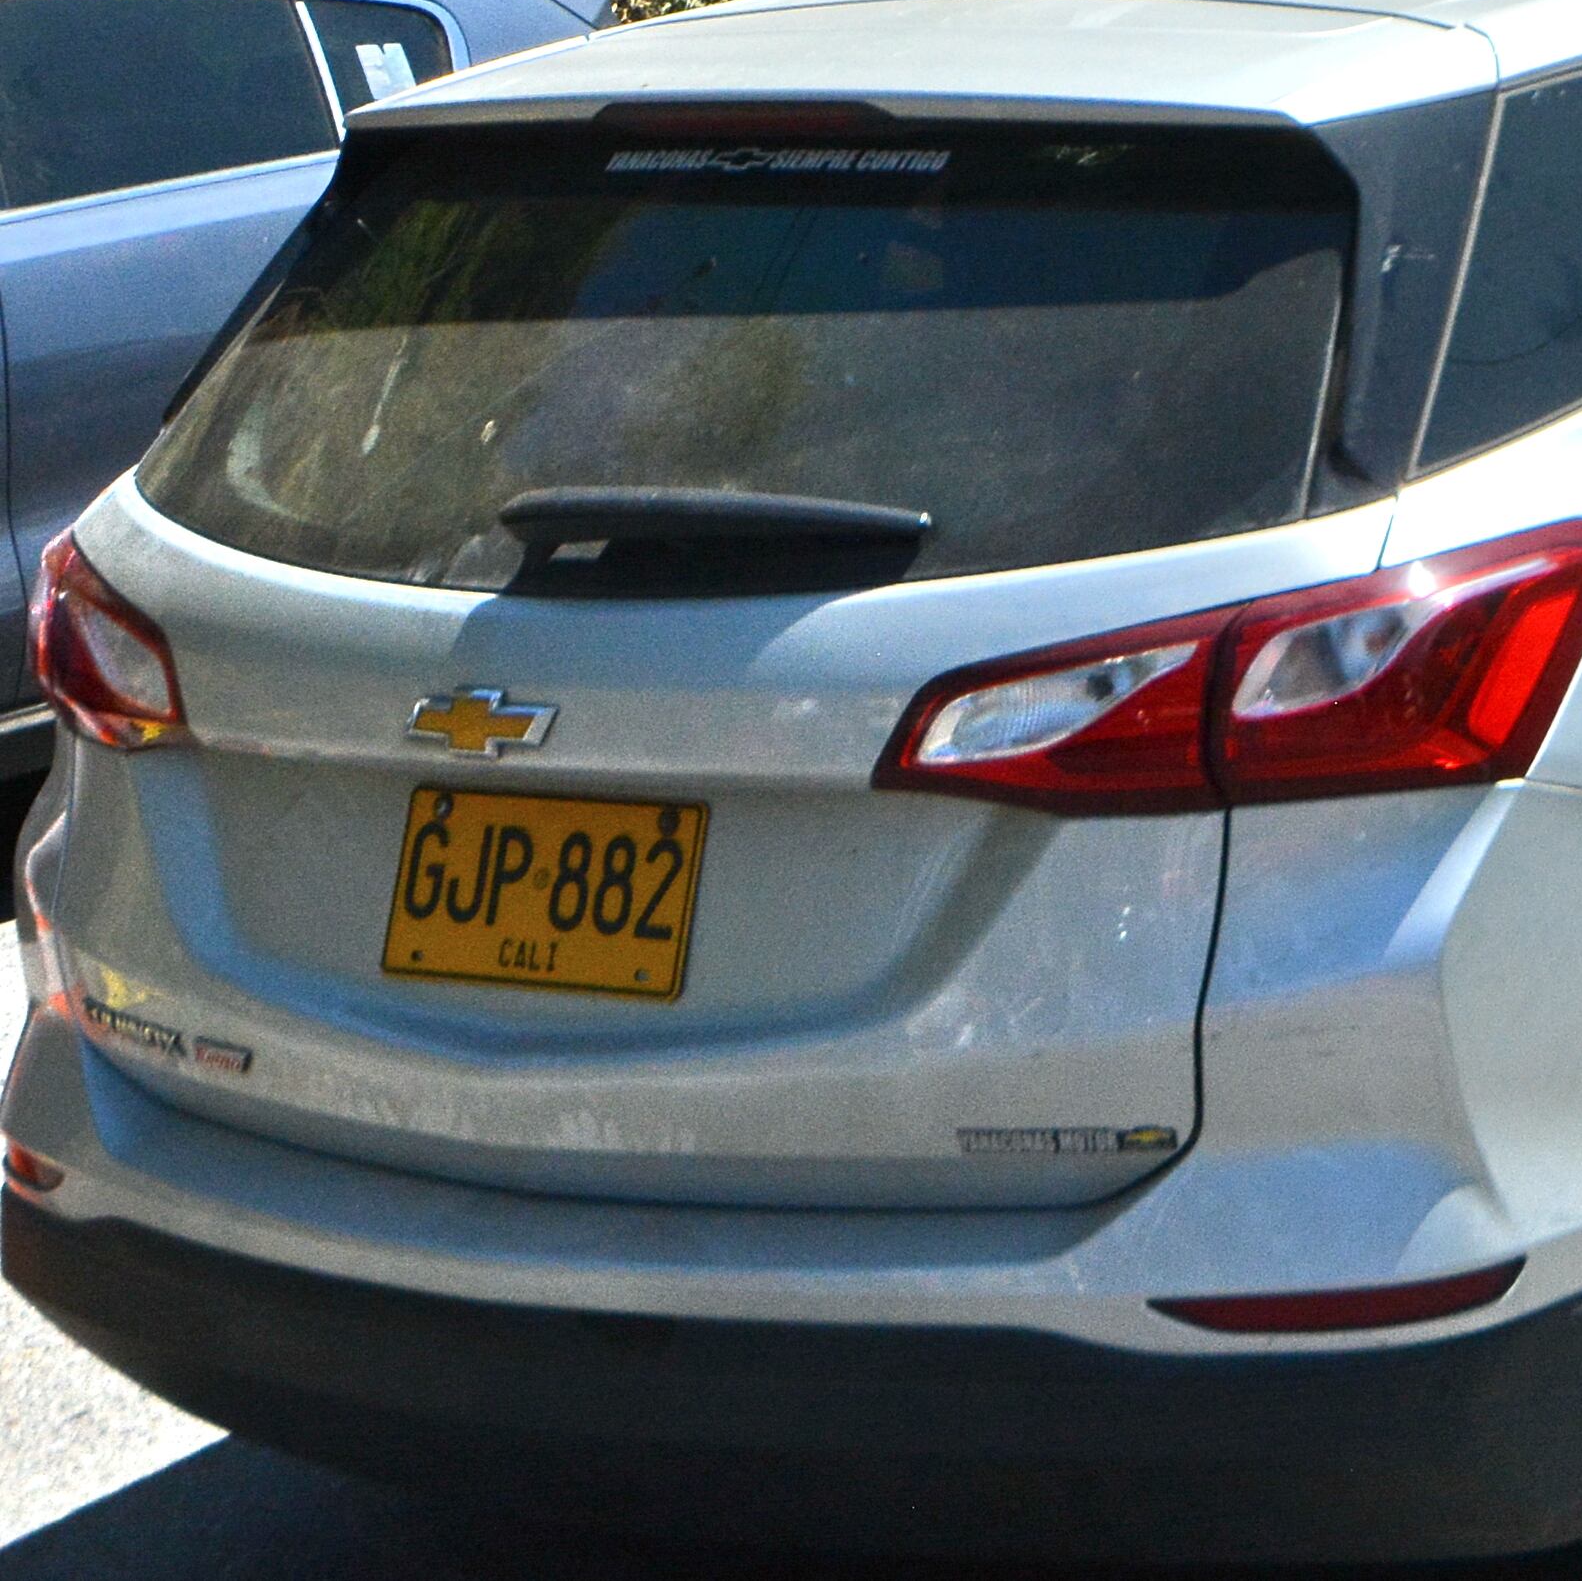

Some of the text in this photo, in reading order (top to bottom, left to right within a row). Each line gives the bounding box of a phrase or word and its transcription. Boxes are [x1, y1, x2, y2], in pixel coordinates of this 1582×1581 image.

[769, 149, 859, 170] SIEMPRE
[857, 149, 951, 171] CONTIGO
[499, 937, 558, 971] CALI
